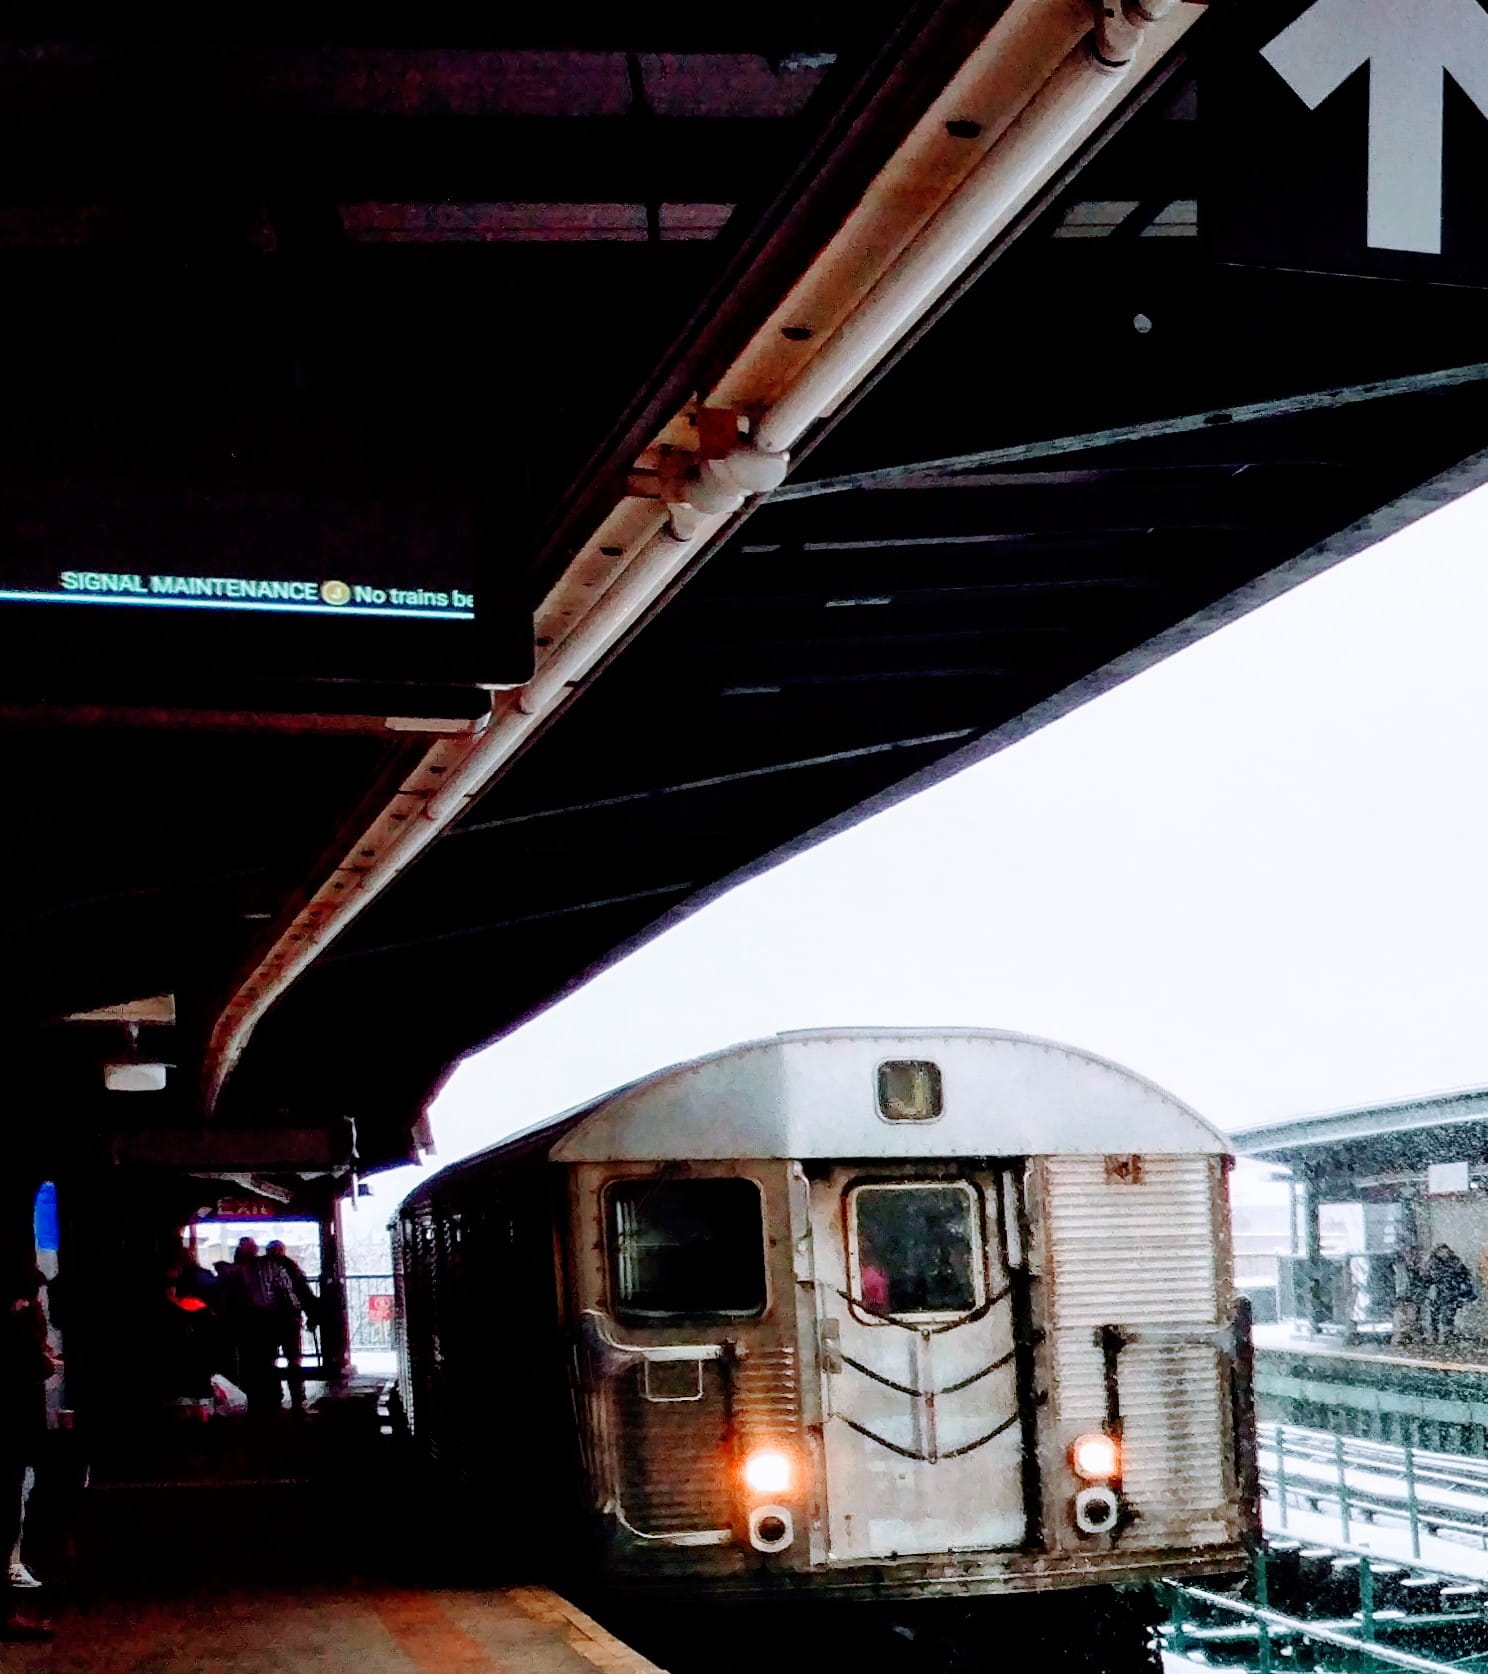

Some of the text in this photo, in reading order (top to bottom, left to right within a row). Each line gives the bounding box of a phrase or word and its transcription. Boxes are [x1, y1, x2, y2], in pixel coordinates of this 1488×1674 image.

[60, 571, 148, 593] SIGNAL
[150, 576, 318, 600] MAINTENANCE
[354, 585, 387, 603] No
[390, 588, 448, 608] trains
